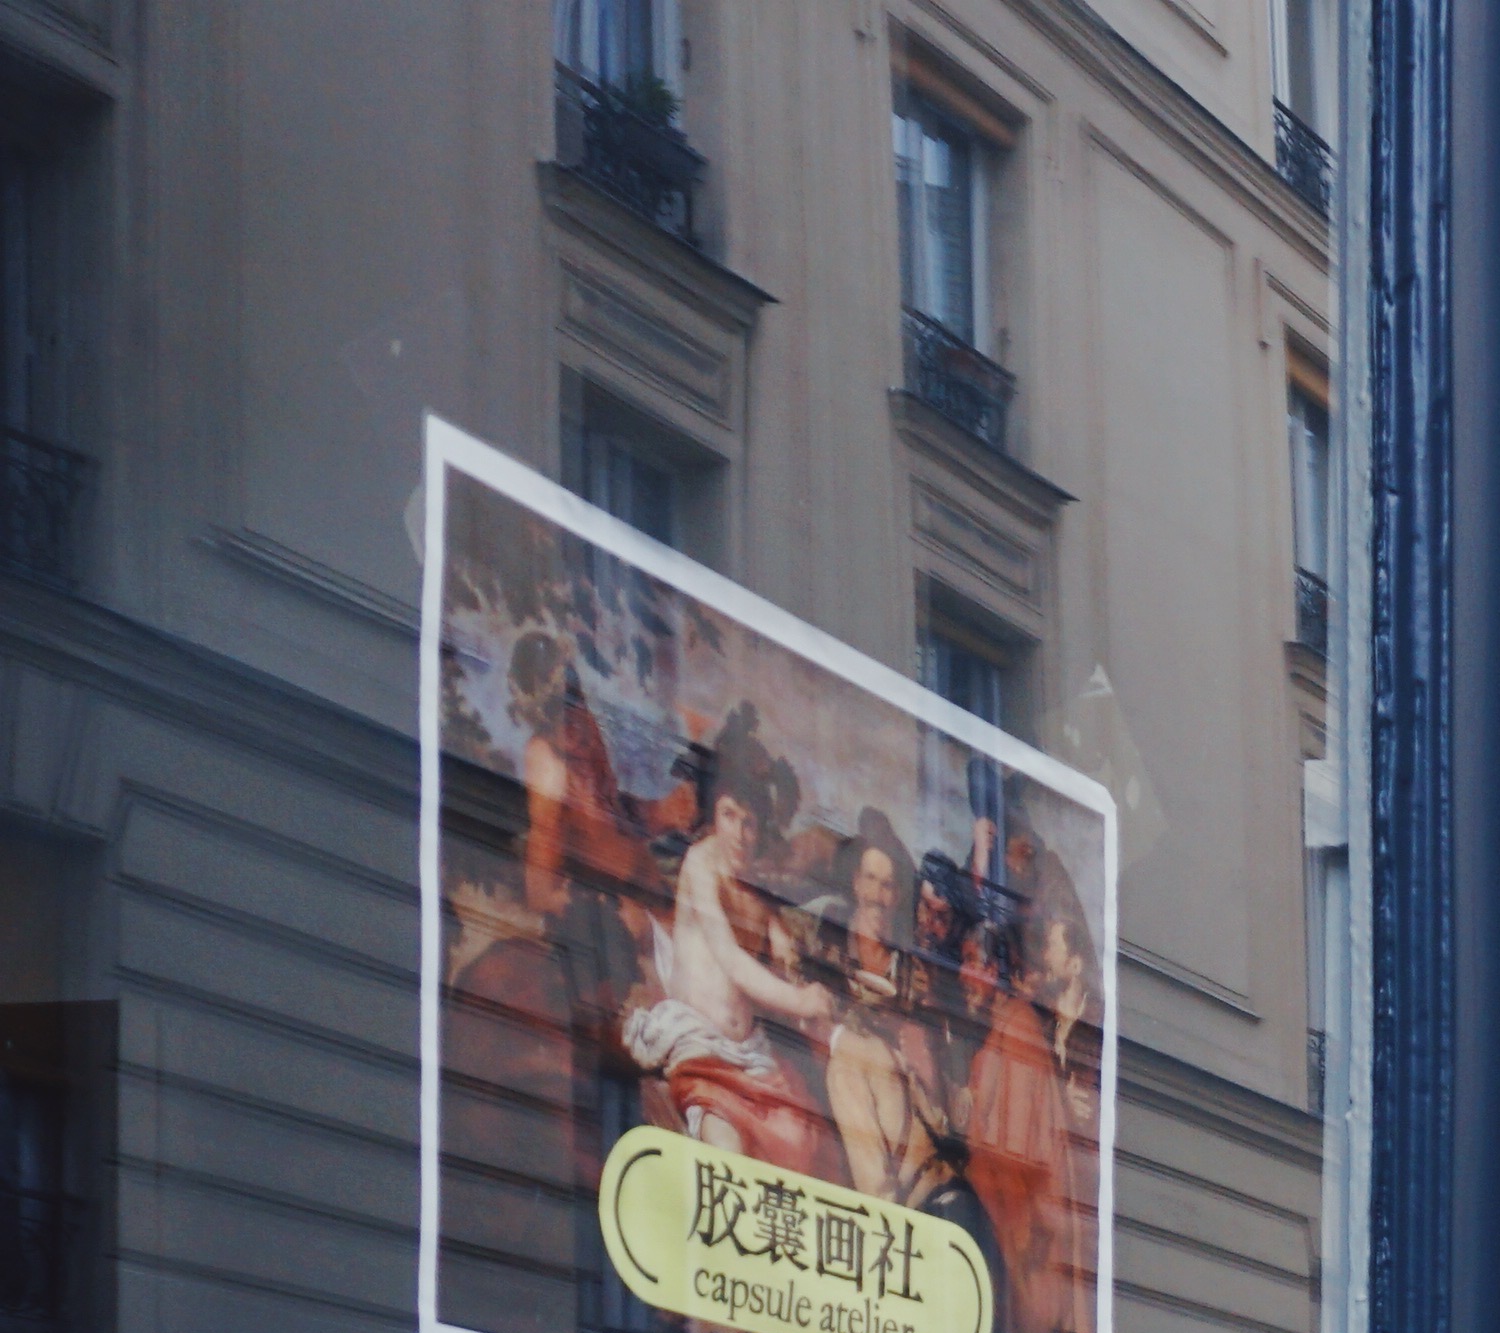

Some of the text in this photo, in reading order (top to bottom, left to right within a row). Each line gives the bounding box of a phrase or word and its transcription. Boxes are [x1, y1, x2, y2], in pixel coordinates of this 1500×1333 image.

[686, 1158, 926, 1303] 胶囊画社
[693, 1266, 812, 1329] capsule
